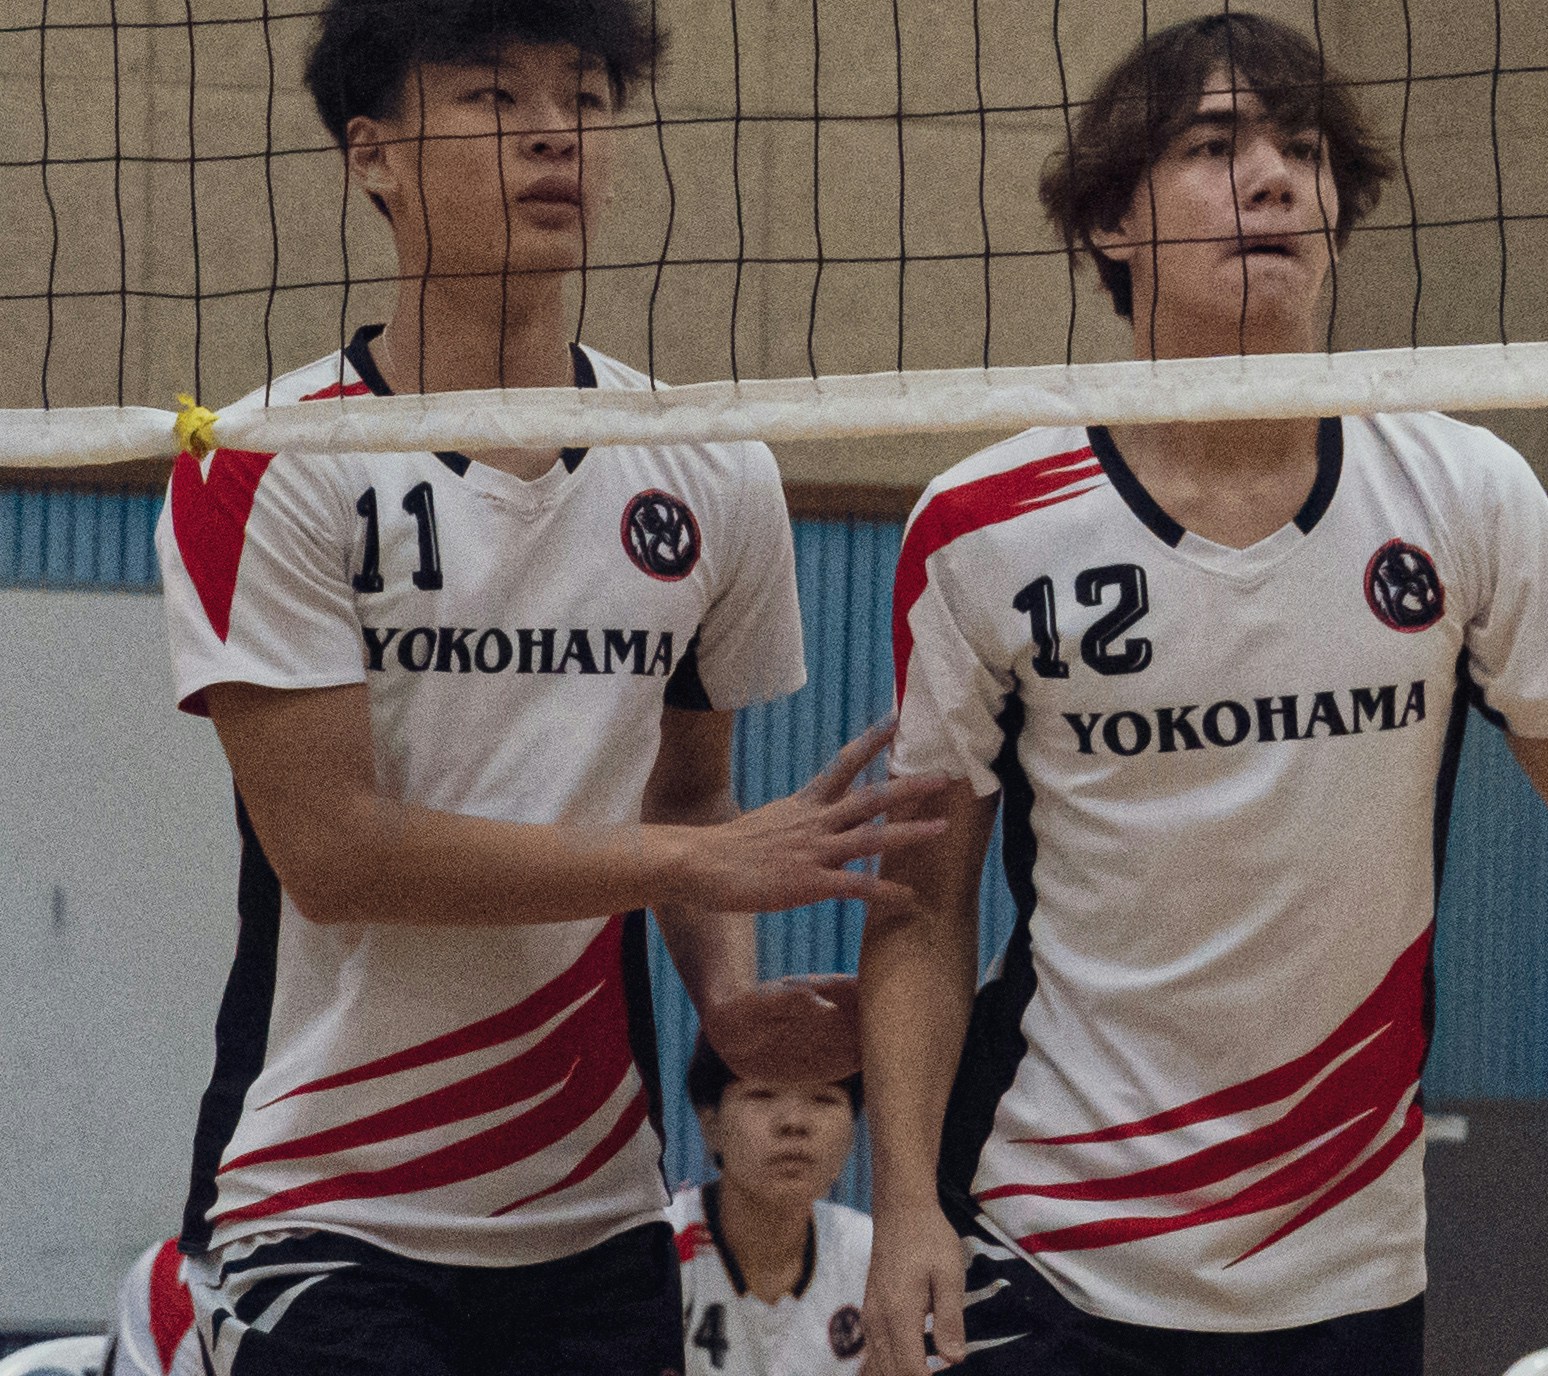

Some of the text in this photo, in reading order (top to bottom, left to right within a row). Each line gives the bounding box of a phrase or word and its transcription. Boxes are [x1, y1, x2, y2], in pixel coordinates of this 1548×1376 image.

[352, 480, 444, 594] 11
[361, 627, 674, 676] YOKOHAMA
[1012, 563, 1153, 679] 12
[1051, 679, 1427, 757] YOKOHAMA
